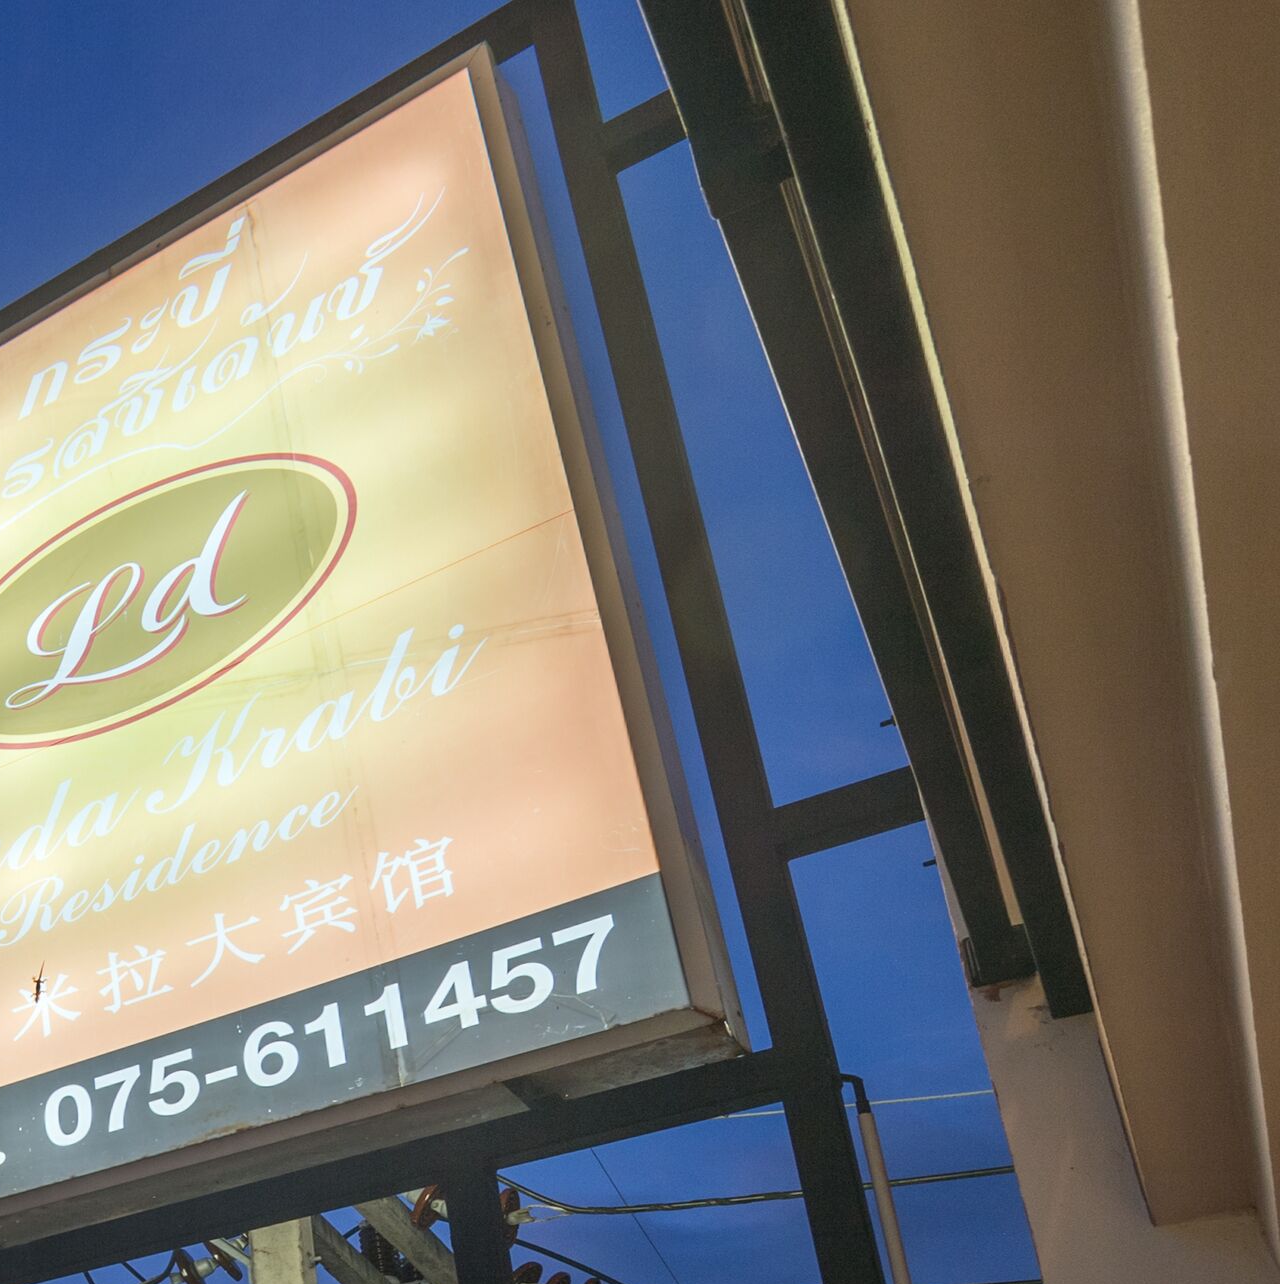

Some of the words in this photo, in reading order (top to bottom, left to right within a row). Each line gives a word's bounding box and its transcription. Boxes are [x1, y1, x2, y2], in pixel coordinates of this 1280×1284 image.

[18, 217, 246, 421] กระบี่
[146, 624, 489, 815] Krabi
[44, 914, 616, 1148] 075-611457
